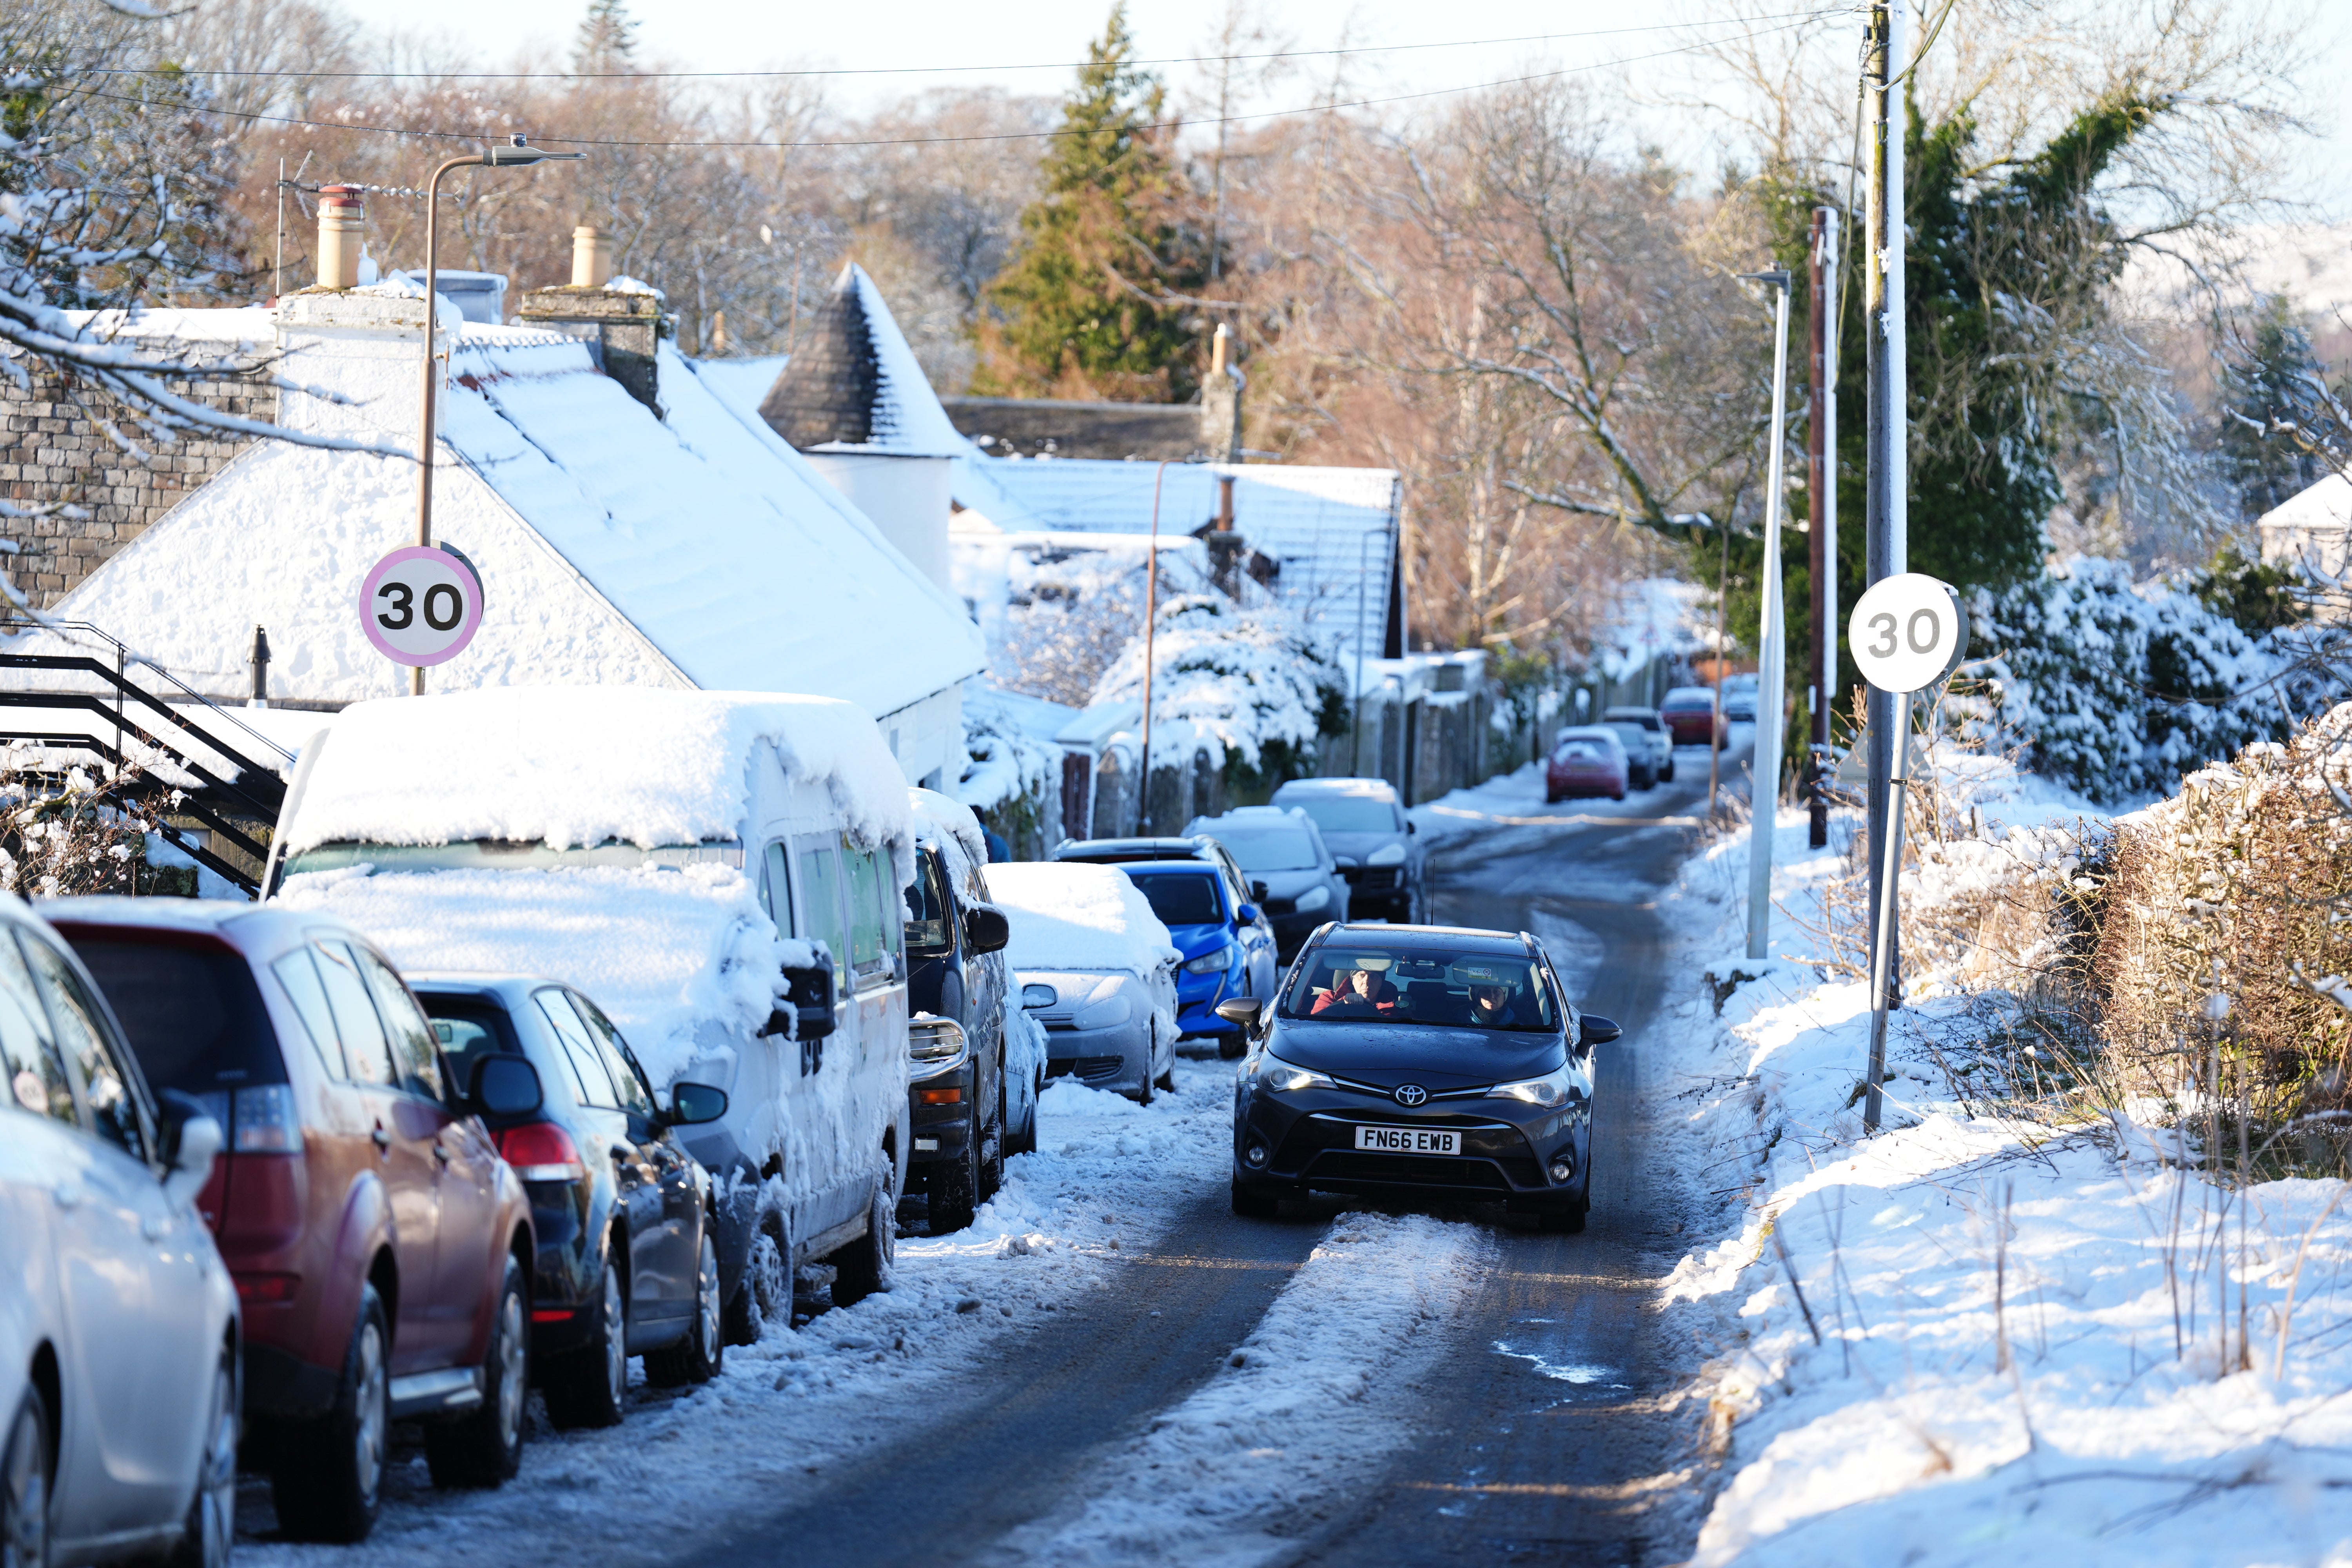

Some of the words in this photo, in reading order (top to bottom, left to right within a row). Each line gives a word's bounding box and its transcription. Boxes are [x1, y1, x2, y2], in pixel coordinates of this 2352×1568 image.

[377, 582, 463, 631] 30
[1868, 608, 1940, 659] 30
[1364, 1129, 1412, 1149] FN66
[1417, 1133, 1453, 1151] EWB
